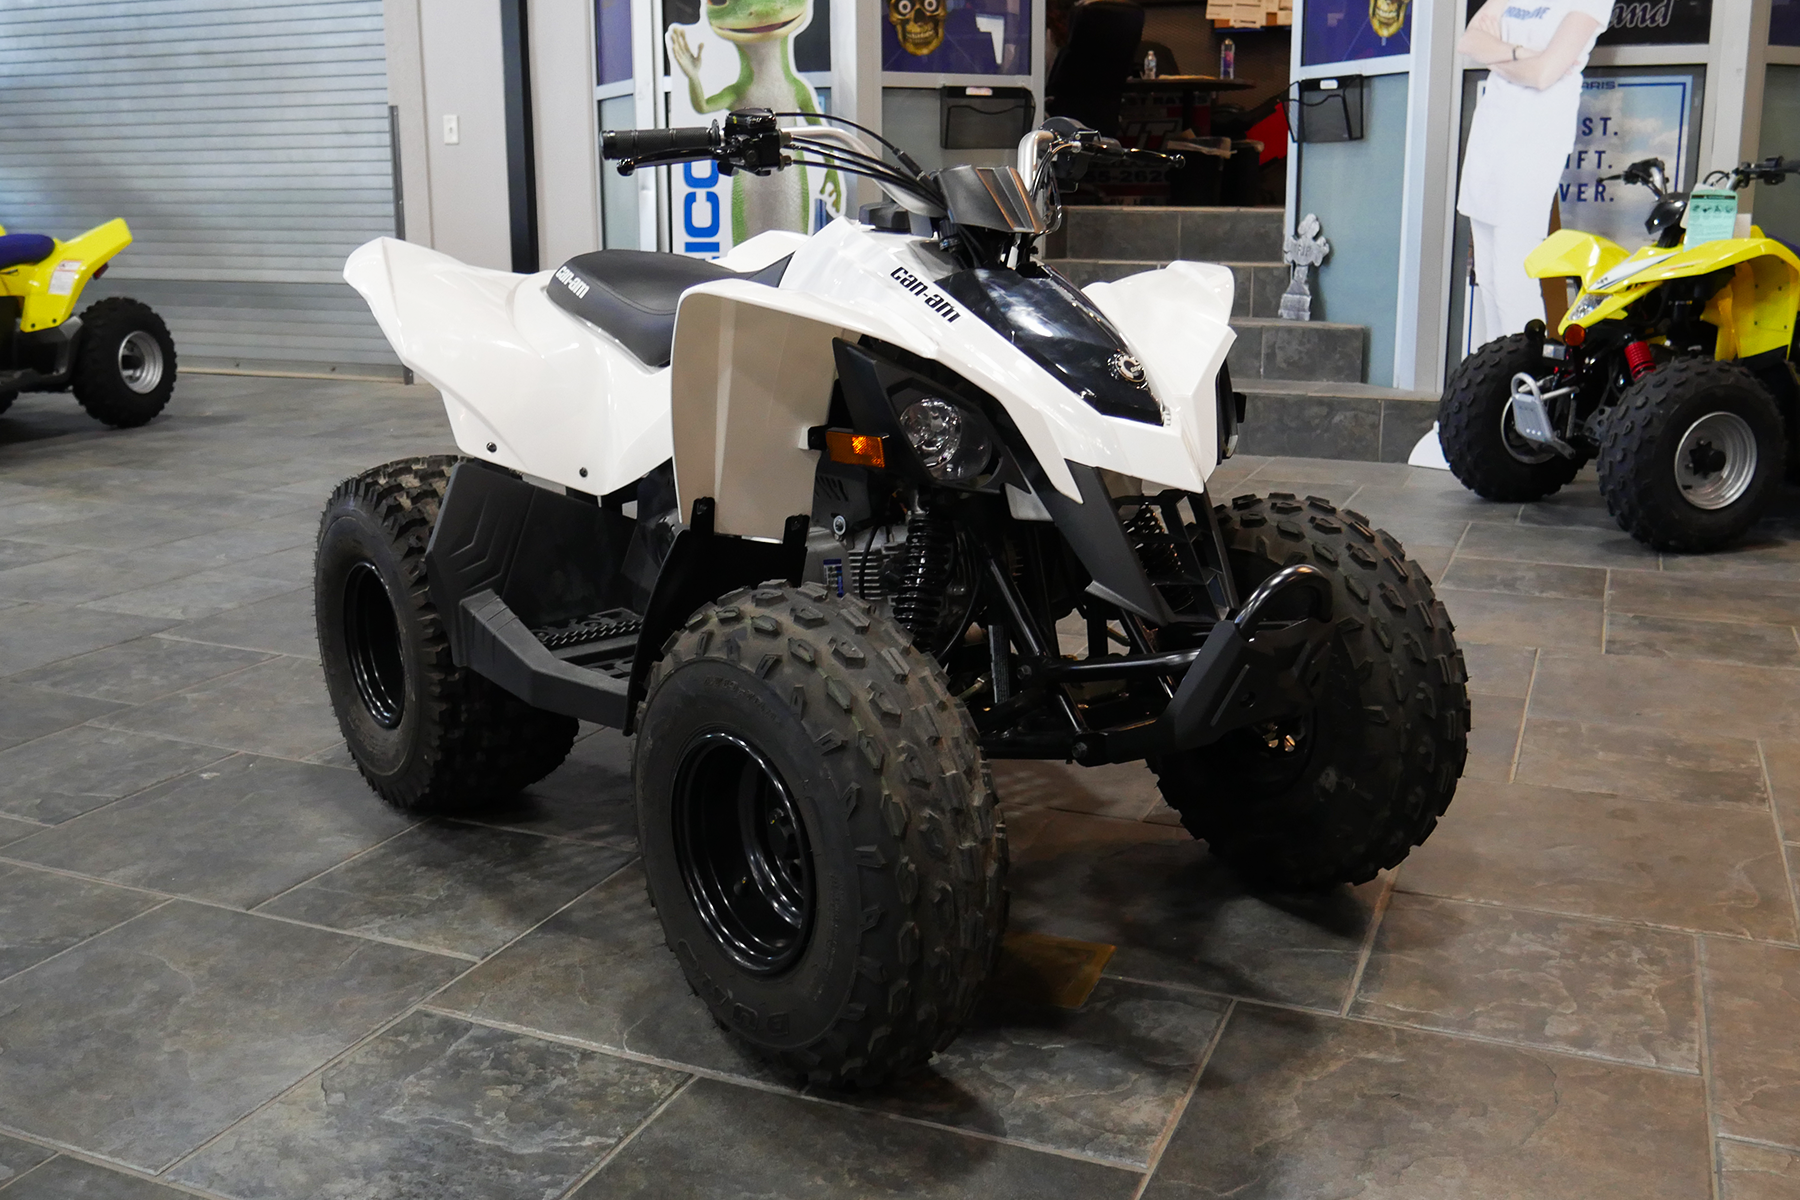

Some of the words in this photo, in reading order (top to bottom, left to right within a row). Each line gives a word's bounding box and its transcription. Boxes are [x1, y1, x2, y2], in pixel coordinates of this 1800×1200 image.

[1581, 117, 1618, 136] ST.
[1559, 183, 1614, 202] VER.
[684, 160, 720, 260] ICO
